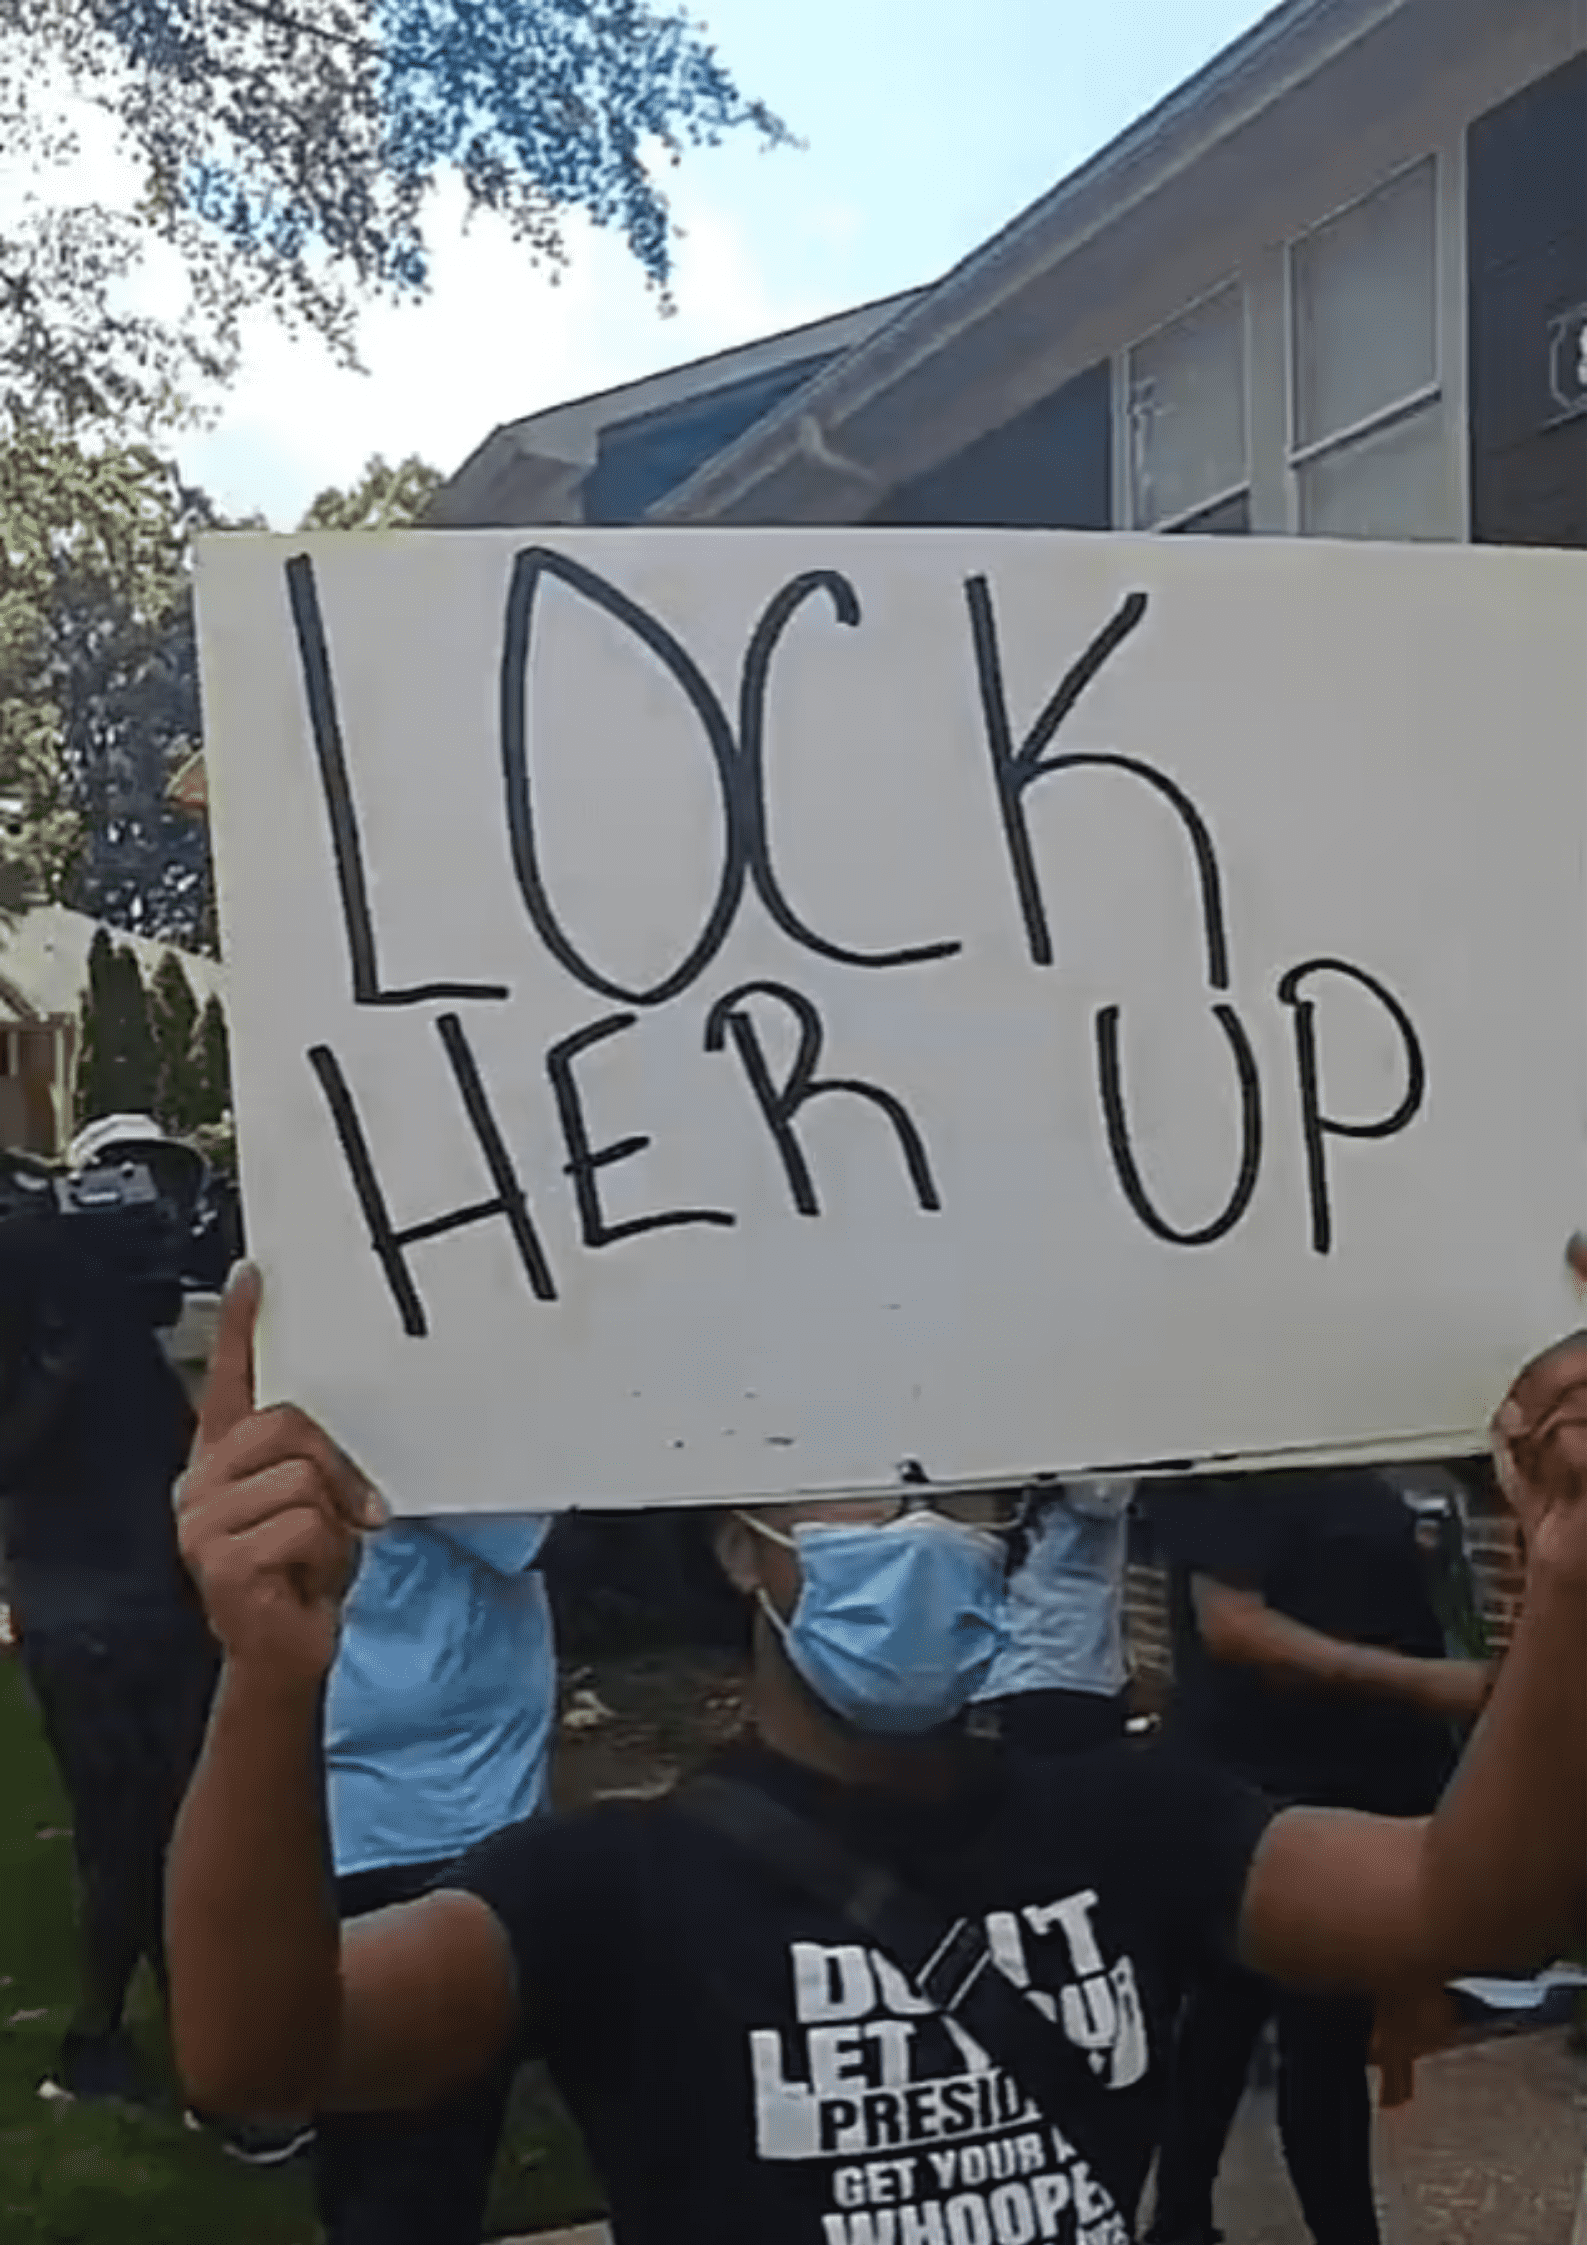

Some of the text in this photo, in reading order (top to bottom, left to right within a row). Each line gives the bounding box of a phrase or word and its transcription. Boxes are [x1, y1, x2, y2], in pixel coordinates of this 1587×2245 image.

[286, 547, 1229, 1007] LOCK
[308, 958, 1425, 1338] HER UP
[749, 2018, 917, 2098] LET
[833, 2156, 918, 2208] GET
[927, 2132, 1046, 2190] YOUR
